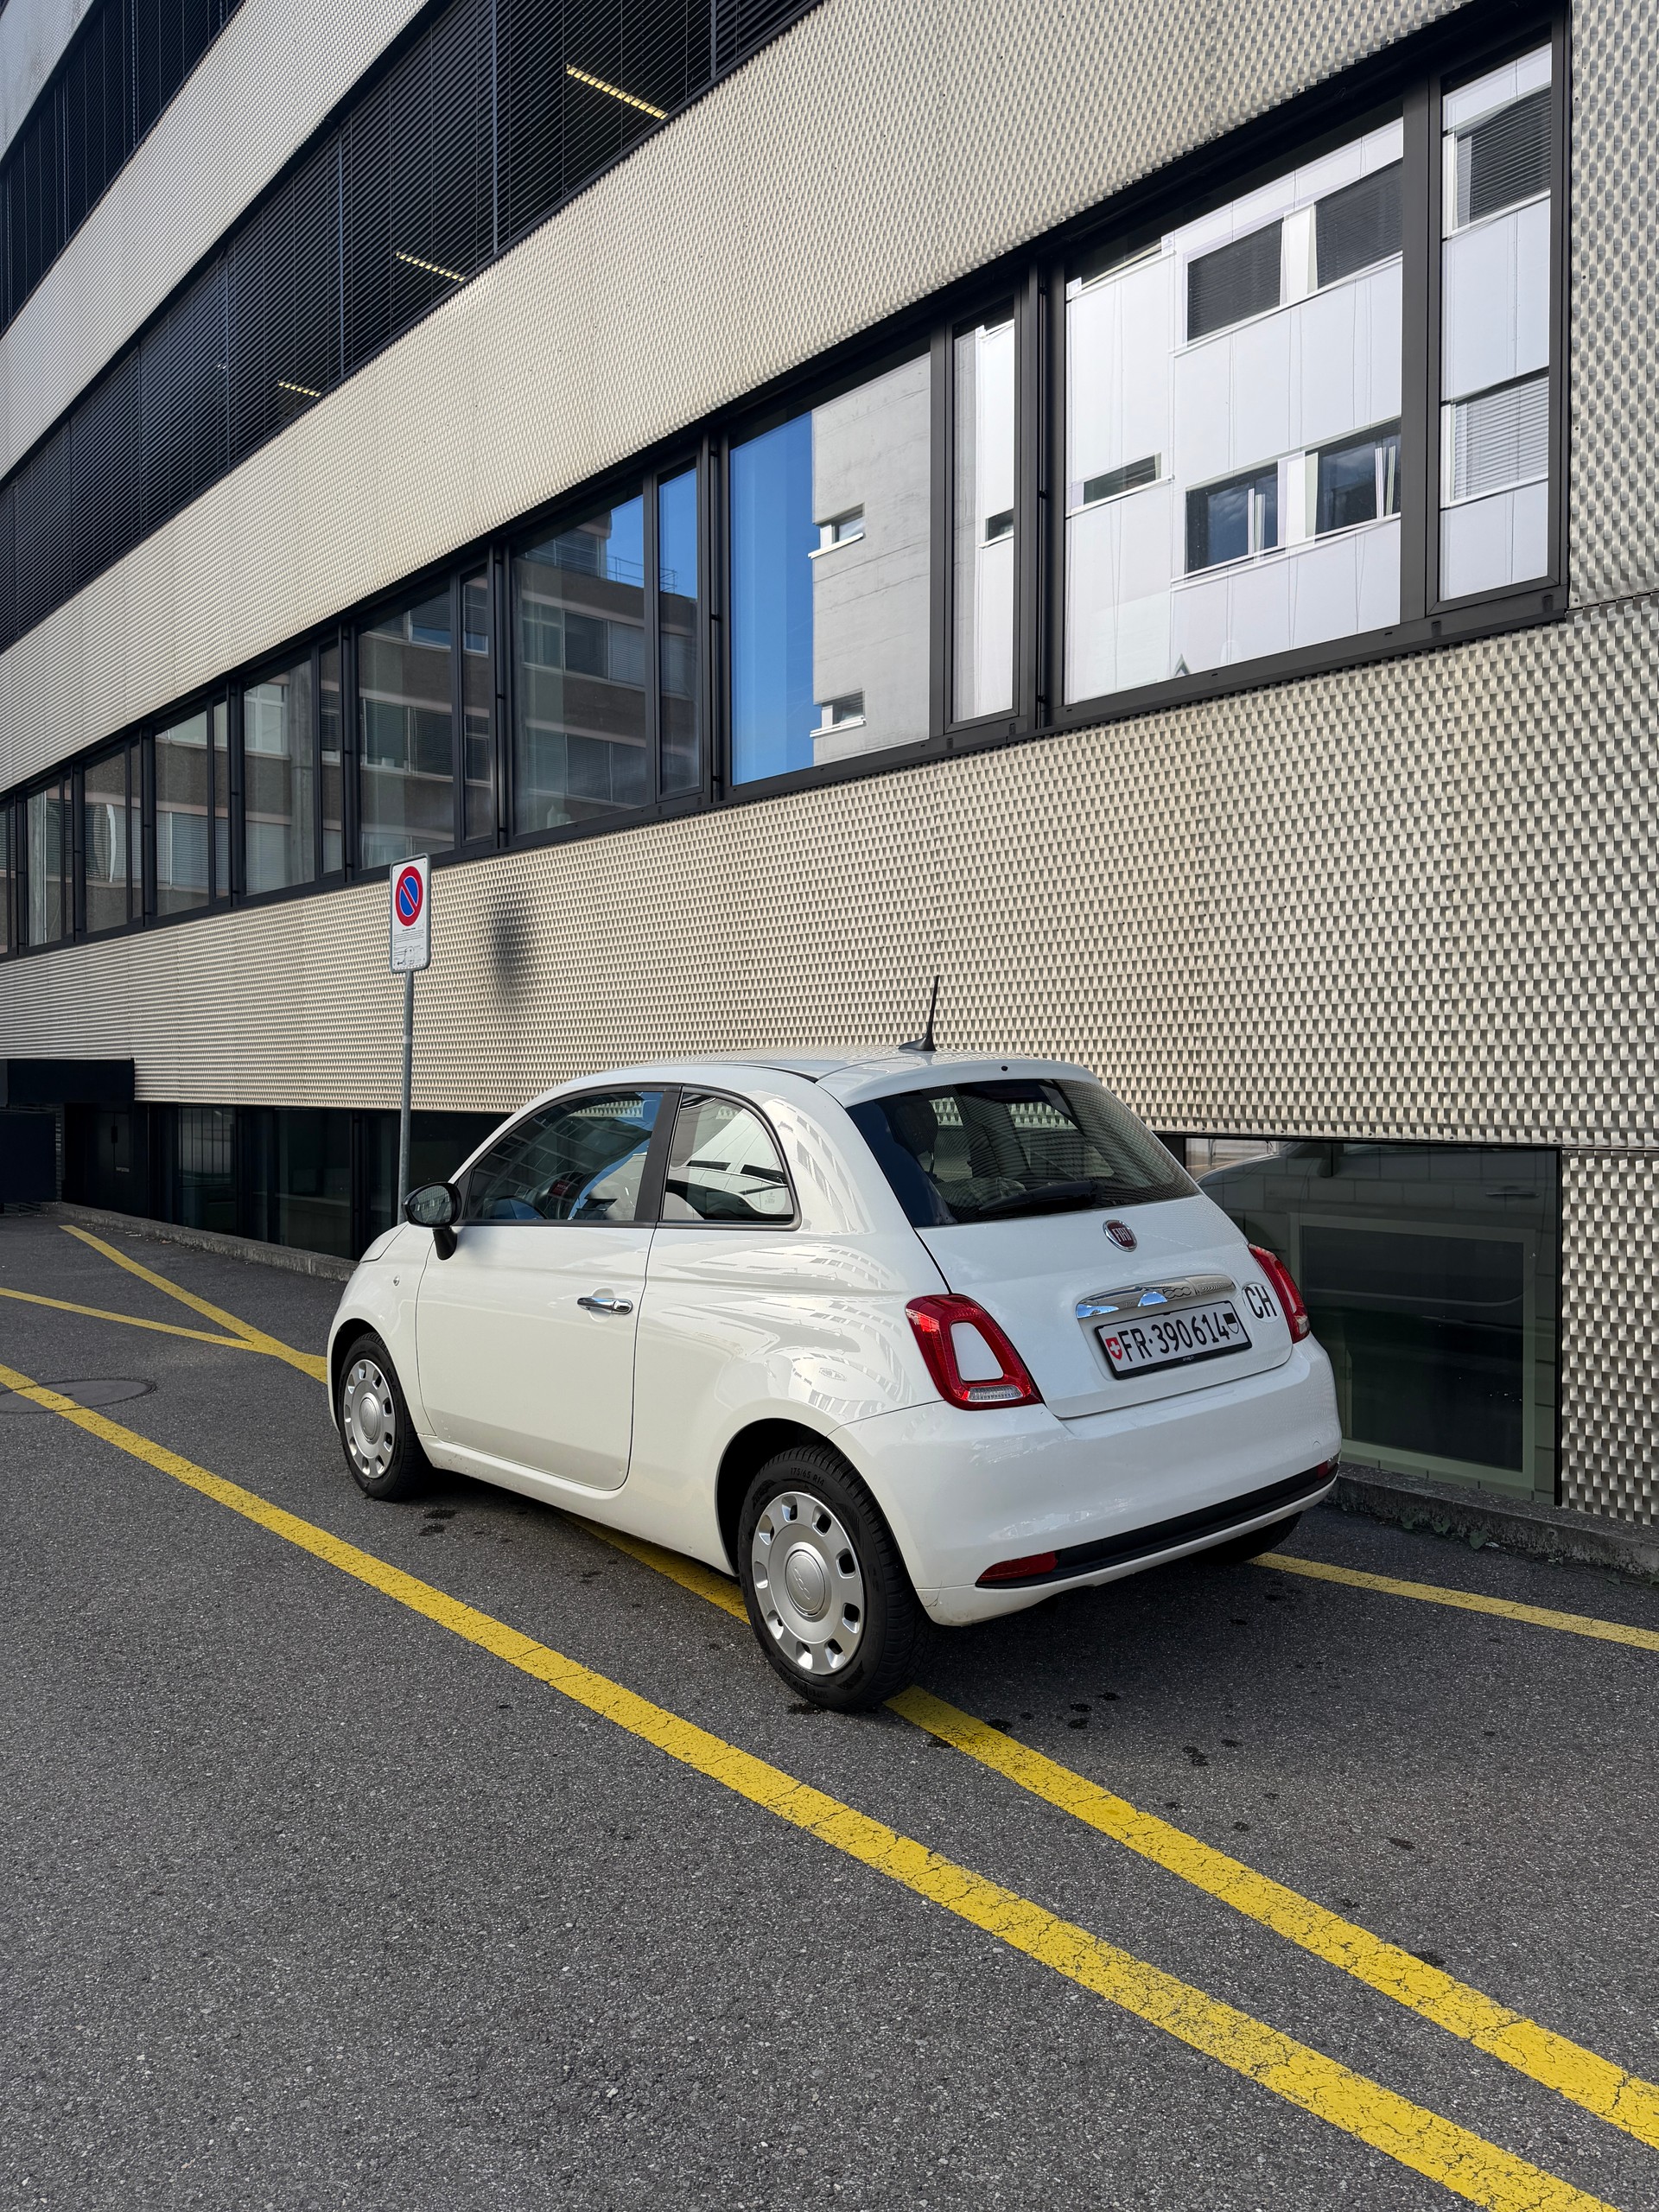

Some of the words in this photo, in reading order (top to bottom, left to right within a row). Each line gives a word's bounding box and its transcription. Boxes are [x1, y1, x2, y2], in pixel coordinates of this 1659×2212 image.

[1112, 1227, 1132, 1243] FIAT
[1162, 1287, 1192, 1300] 500
[1243, 1286, 1278, 1319] CH
[790, 1466, 810, 1479] 175/65
[812, 1473, 825, 1486] R14
